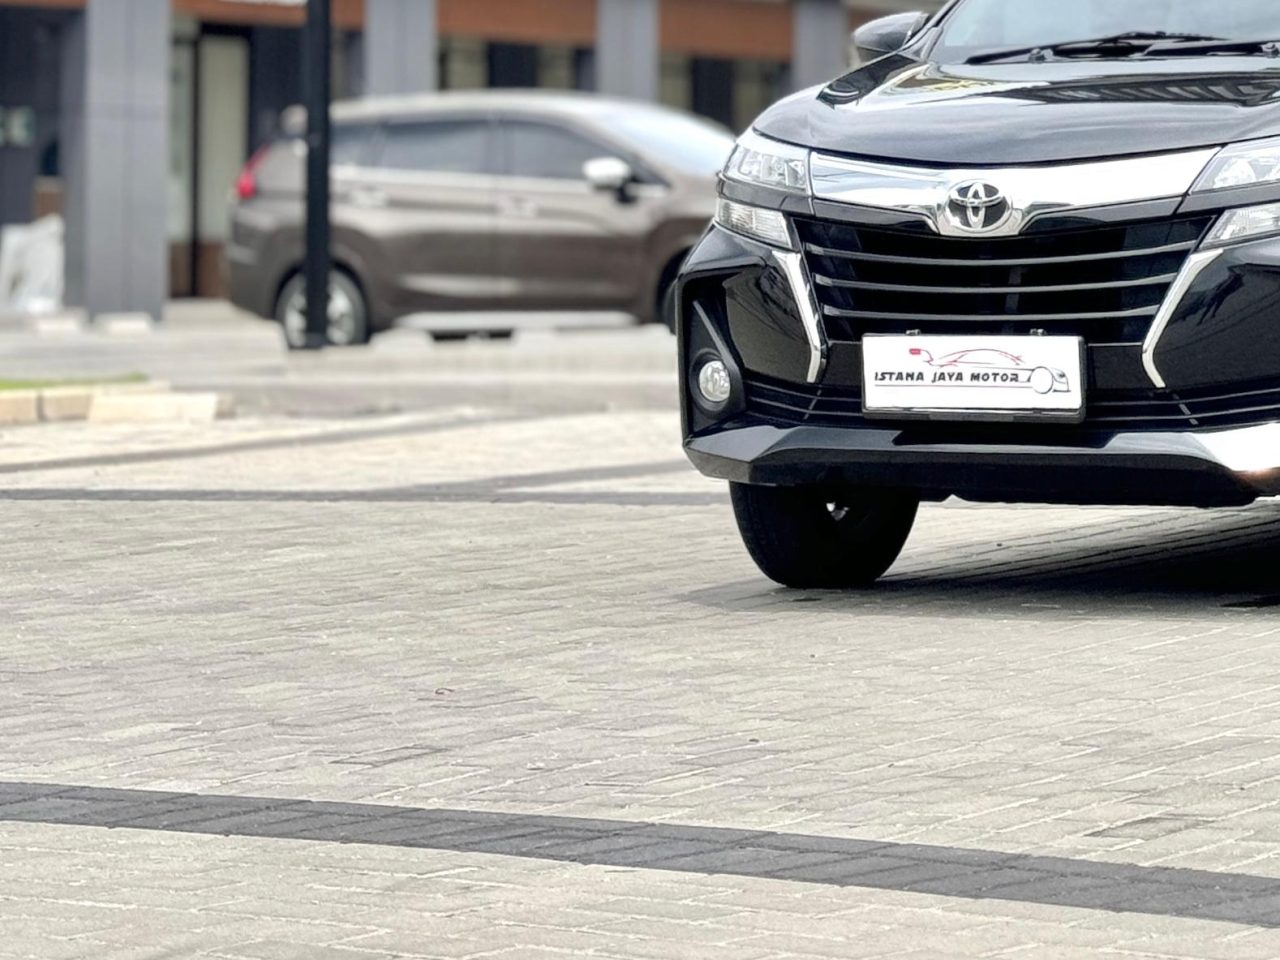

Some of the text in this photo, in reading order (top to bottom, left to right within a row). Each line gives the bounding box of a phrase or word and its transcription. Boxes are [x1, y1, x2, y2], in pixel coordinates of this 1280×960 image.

[873, 371, 1020, 383] ISTANA JAYA MOTOR
